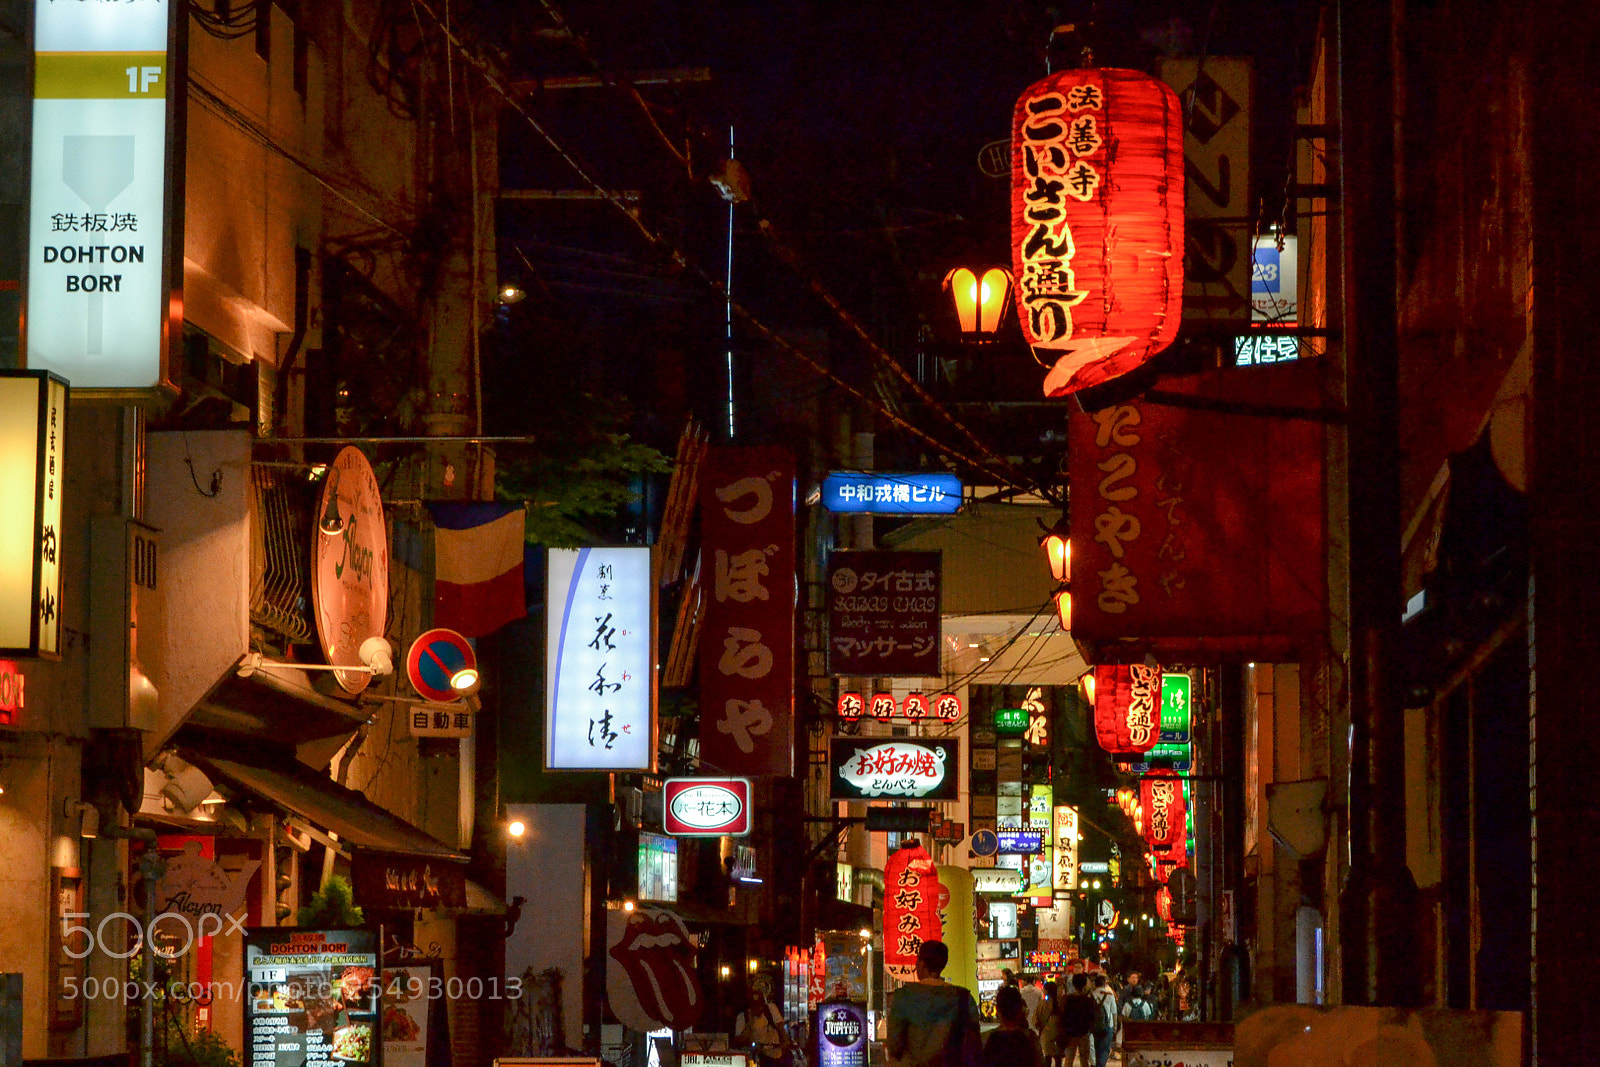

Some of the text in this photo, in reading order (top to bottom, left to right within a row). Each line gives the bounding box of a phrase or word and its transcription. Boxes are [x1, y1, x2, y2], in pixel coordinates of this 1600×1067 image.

[126, 66, 161, 93] 1F
[1068, 83, 1103, 202] 法善寺
[51, 213, 138, 232] 鉄板焼
[1021, 92, 1088, 343] こいさん通り
[43, 245, 144, 263] DOHTON
[66, 275, 121, 292] BORI
[839, 483, 945, 503] 中和戎橋ビル
[1093, 404, 1141, 614] たこやき
[860, 569, 936, 592] タイ古式
[833, 635, 935, 657] マッサージ
[412, 711, 470, 729] 自動車
[843, 696, 960, 721] お好み焼
[856, 746, 937, 778] お好み焼
[678, 800, 733, 817] バー花本
[894, 867, 923, 956] お好み焼
